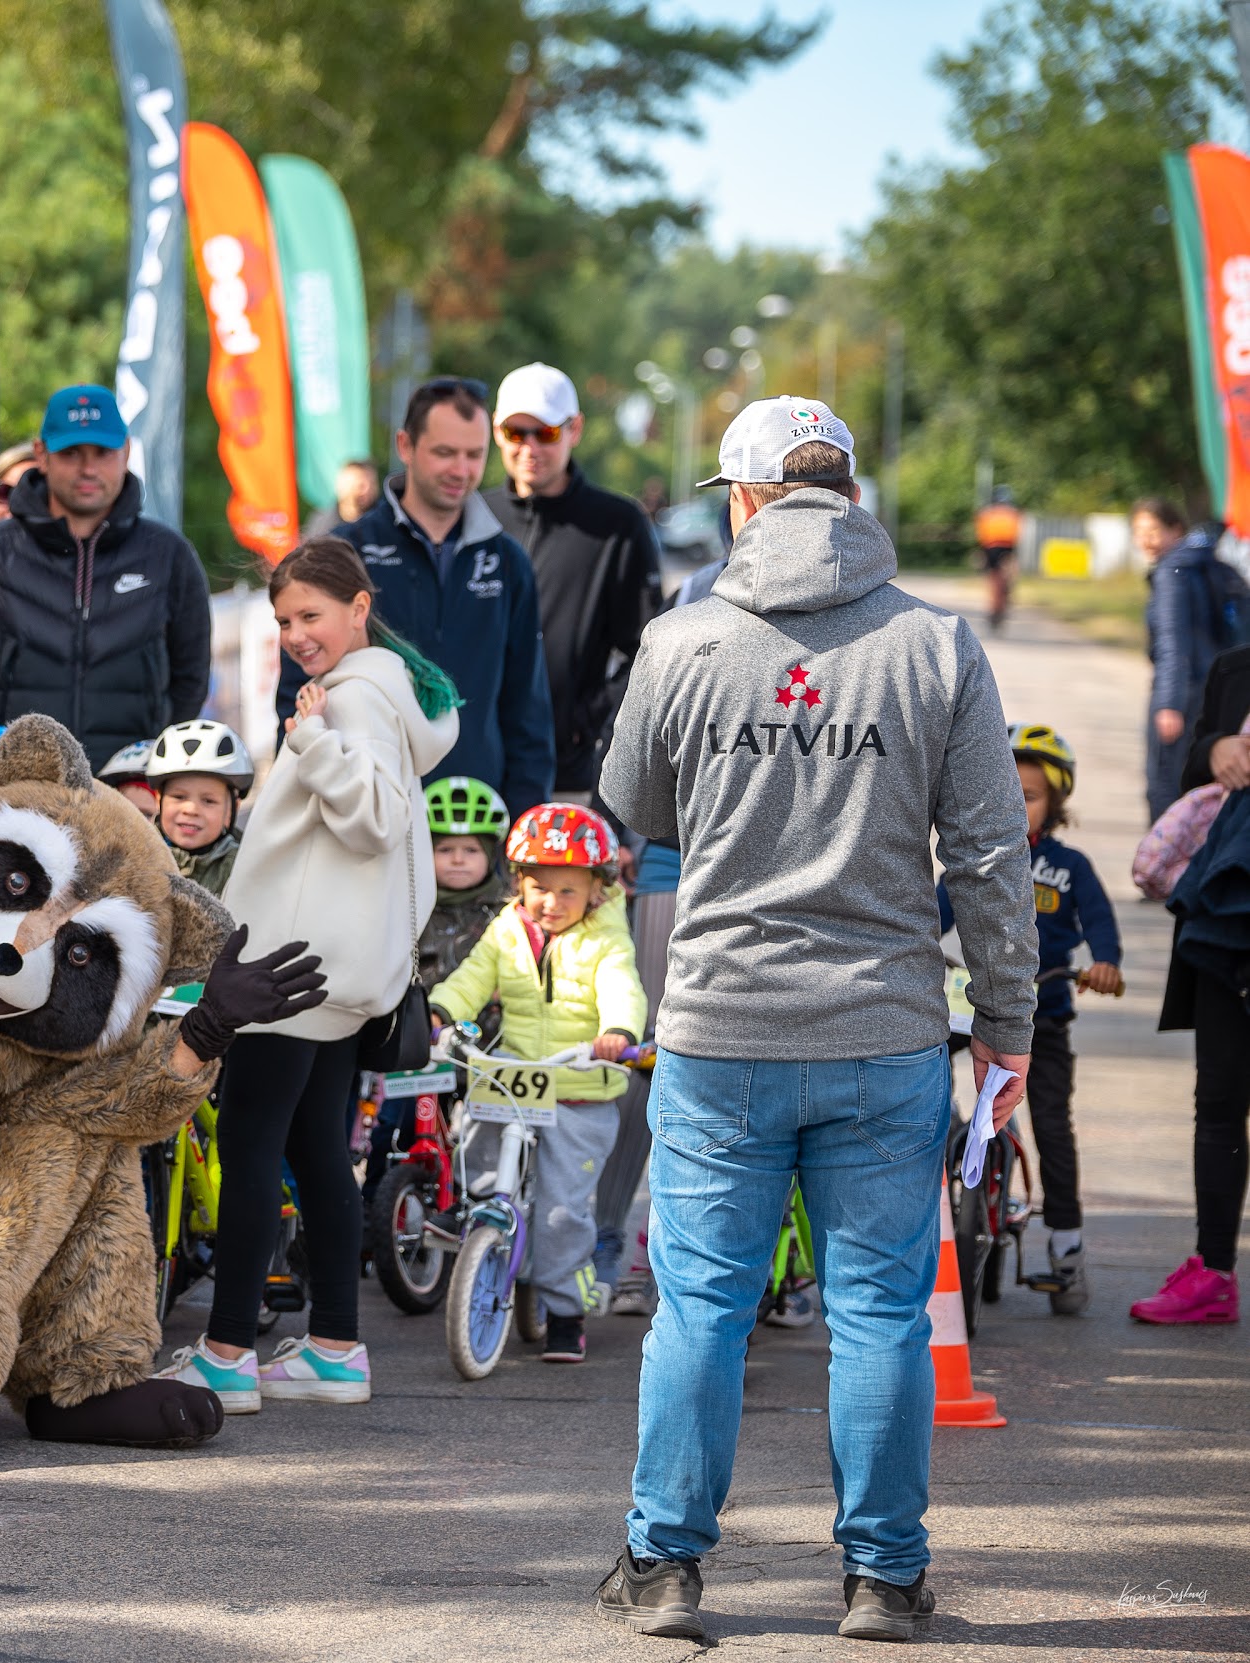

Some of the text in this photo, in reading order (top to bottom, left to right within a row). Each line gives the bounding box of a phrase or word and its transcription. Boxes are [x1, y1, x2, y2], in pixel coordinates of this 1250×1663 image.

[791, 425, 833, 438] ZUTIS
[708, 723, 887, 760] LATVIJA
[489, 1068, 549, 1099] 469
